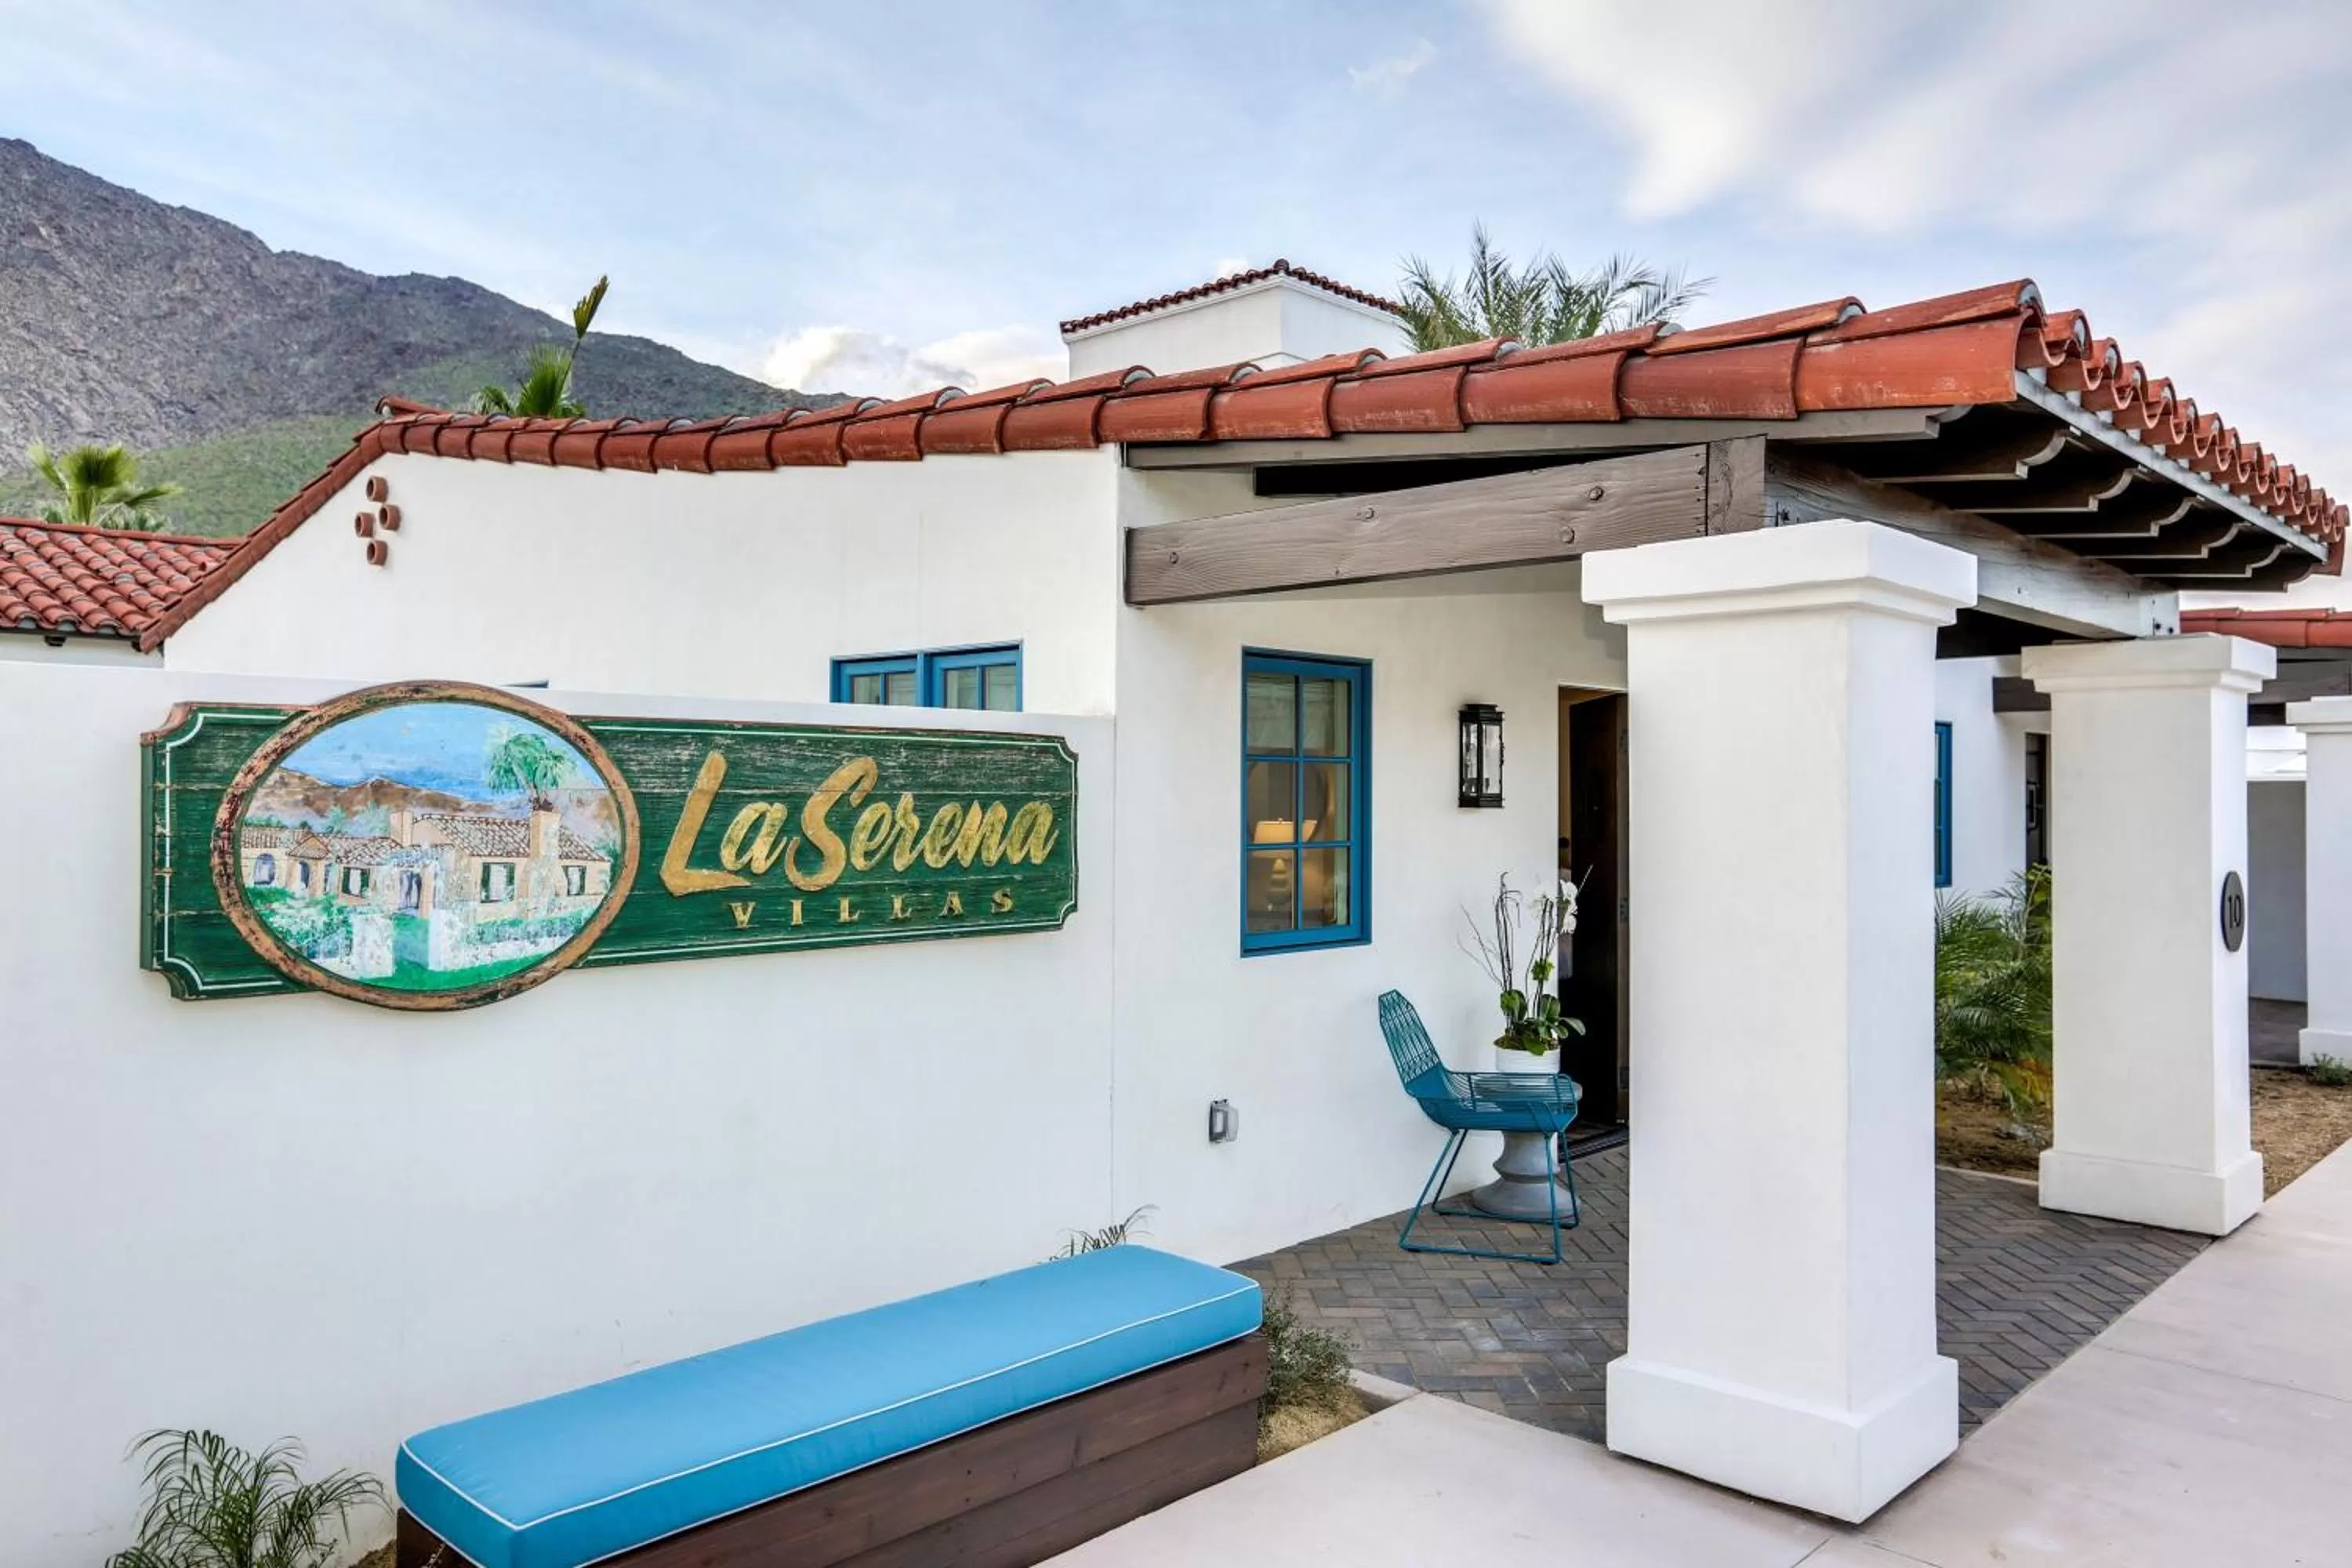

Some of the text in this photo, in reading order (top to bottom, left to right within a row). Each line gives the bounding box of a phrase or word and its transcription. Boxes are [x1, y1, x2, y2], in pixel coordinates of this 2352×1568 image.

[660, 751, 1058, 897] La Serena
[730, 889, 1014, 929] VILLAS
[2227, 895, 2241, 928] 10
